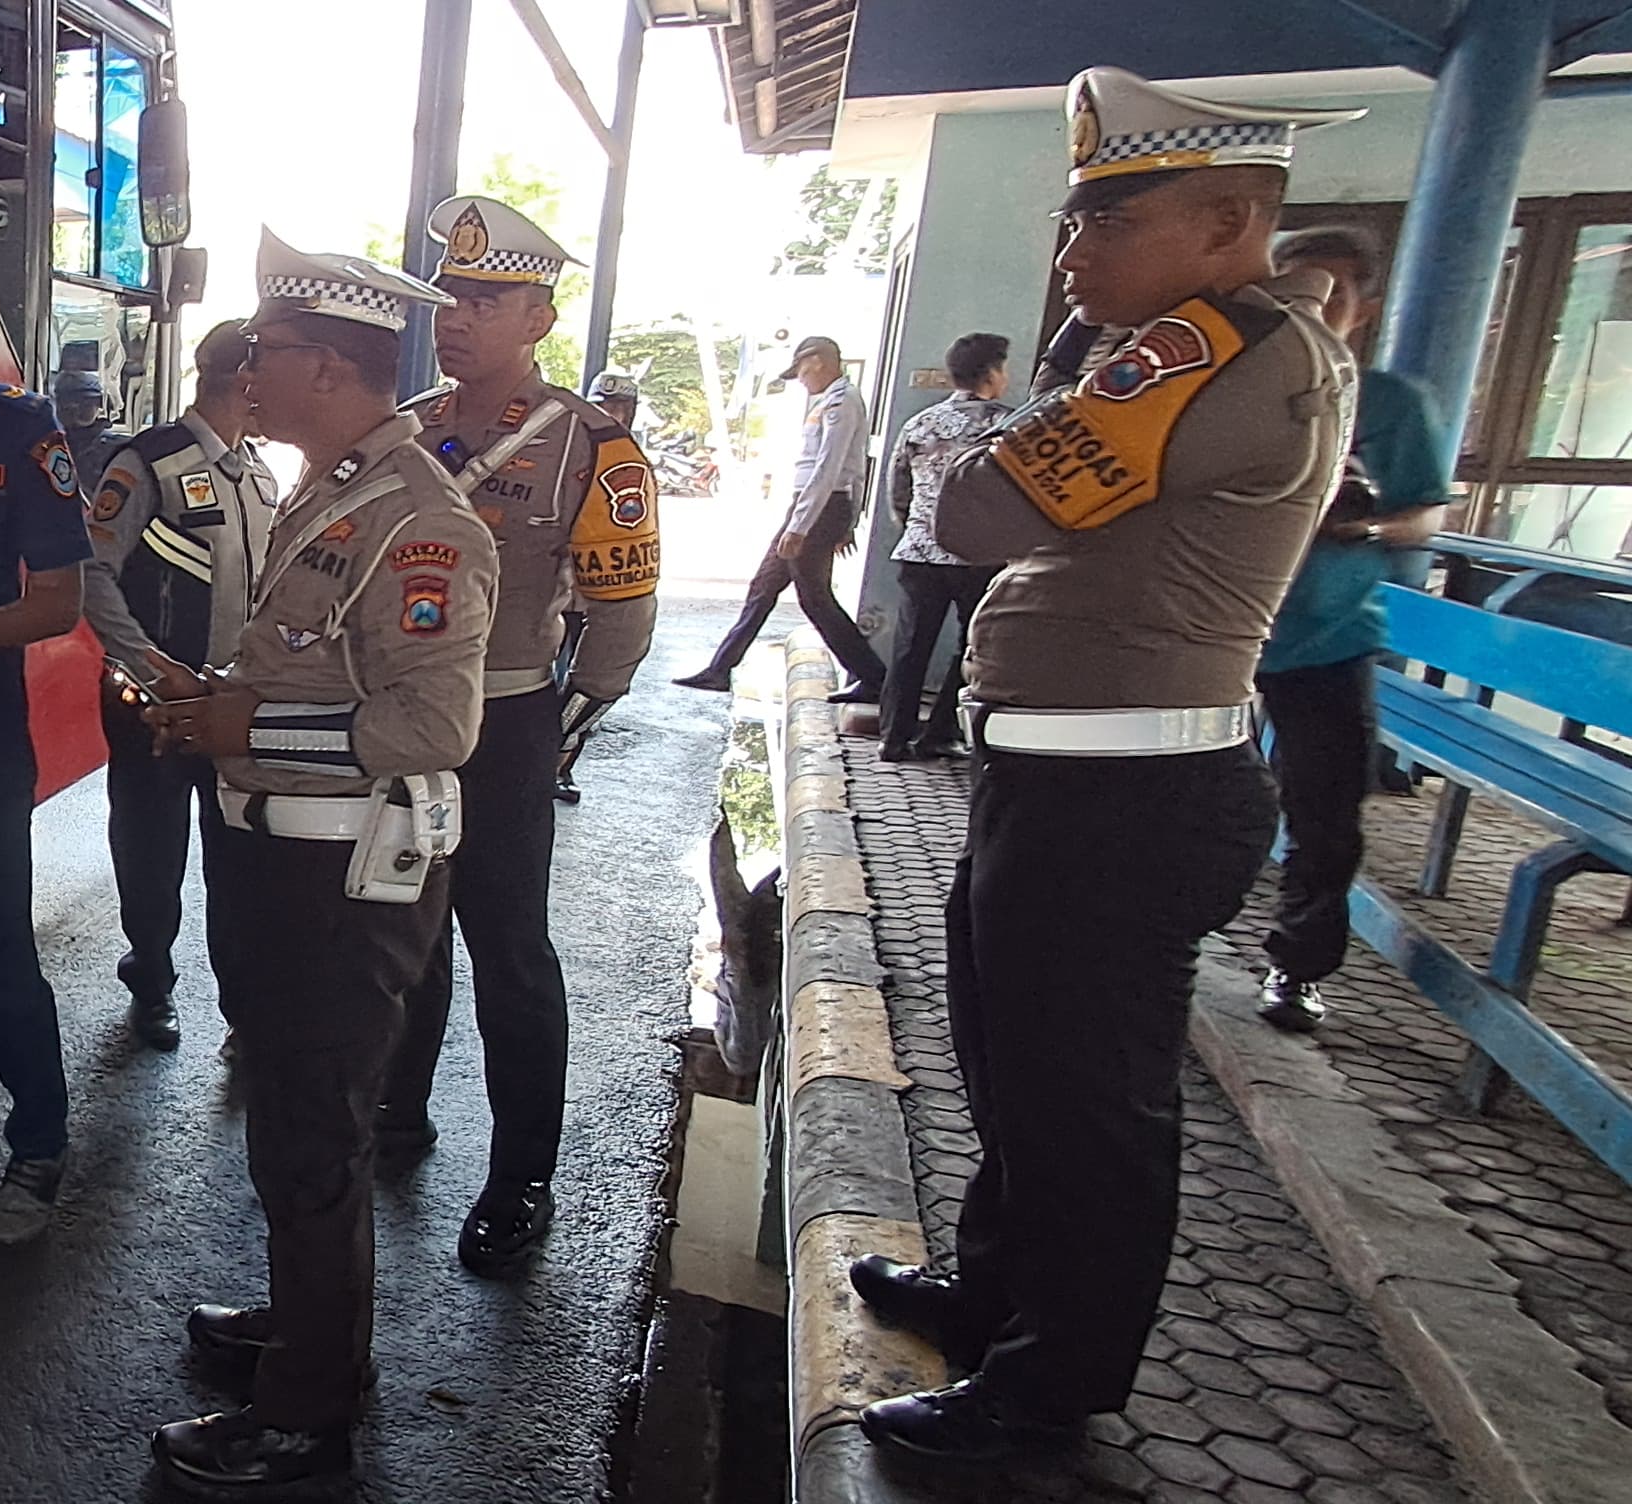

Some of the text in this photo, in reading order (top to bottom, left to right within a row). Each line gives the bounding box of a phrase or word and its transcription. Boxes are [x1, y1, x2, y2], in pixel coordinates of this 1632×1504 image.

[485, 478, 533, 502] OLRI
[302, 546, 347, 579] OLRI
[610, 540, 659, 571] SATG
